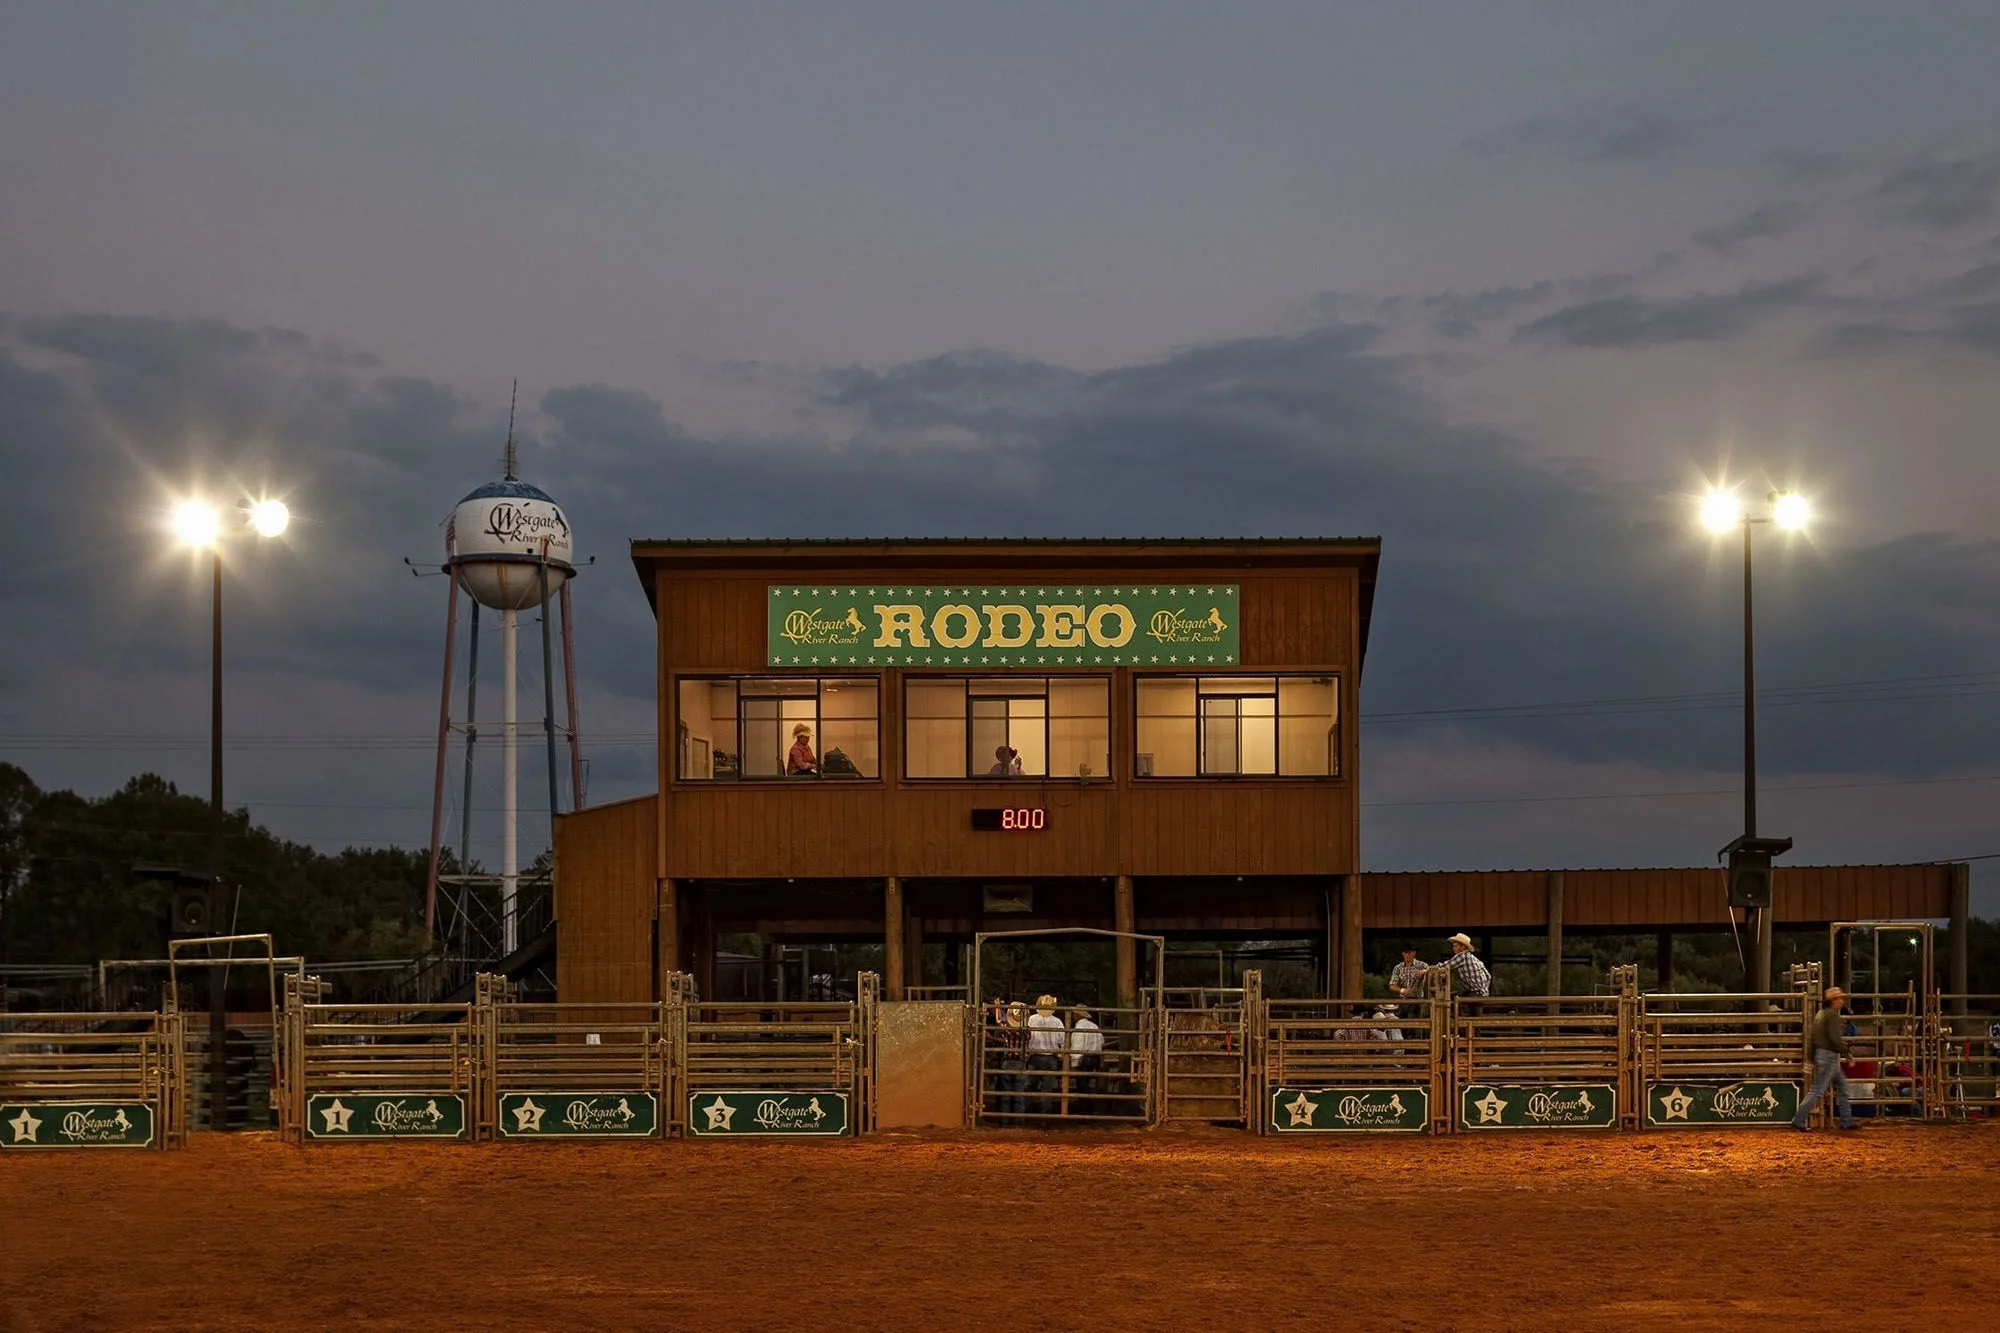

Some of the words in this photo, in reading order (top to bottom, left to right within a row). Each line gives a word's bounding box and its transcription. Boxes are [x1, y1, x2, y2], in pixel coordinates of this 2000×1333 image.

[490, 503, 555, 532] Westgate
[785, 609, 845, 635] Westgate
[873, 604, 1137, 648] RODEO
[1151, 609, 1207, 635] Westgate
[801, 635, 827, 645] River
[828, 633, 859, 645] Ranch
[1167, 633, 1191, 643] River
[1192, 632, 1220, 643] Ranch
[1339, 1095, 1390, 1119] Westgate
[1529, 1092, 1579, 1116] Westgate
[1671, 1097, 1683, 1112] 6
[1714, 1088, 1763, 1112] Westgate
[331, 1109, 341, 1125] 1
[375, 1101, 427, 1126] Westgate
[523, 1110, 535, 1124] 2
[567, 1100, 619, 1124] Westgate
[714, 1108, 725, 1123] 3
[758, 1099, 809, 1123] Westgate
[1295, 1103, 1308, 1119] 4
[1486, 1102, 1497, 1116] 5
[1543, 1111, 1563, 1121] River
[1564, 1111, 1589, 1121] Ranch
[1727, 1108, 1748, 1118] River
[1749, 1108, 1773, 1118] Ranch
[20, 1119, 29, 1135] 1
[63, 1111, 115, 1136] Westgate
[389, 1120, 410, 1131] River
[411, 1120, 438, 1131] Ranch
[581, 1120, 601, 1129] River
[603, 1120, 628, 1129] Ranch
[771, 1119, 792, 1128] River
[794, 1119, 820, 1128] Ranch
[1353, 1115, 1374, 1125] River
[1375, 1115, 1401, 1125] Ranch
[76, 1130, 98, 1140] River
[99, 1130, 126, 1140] Ranch
